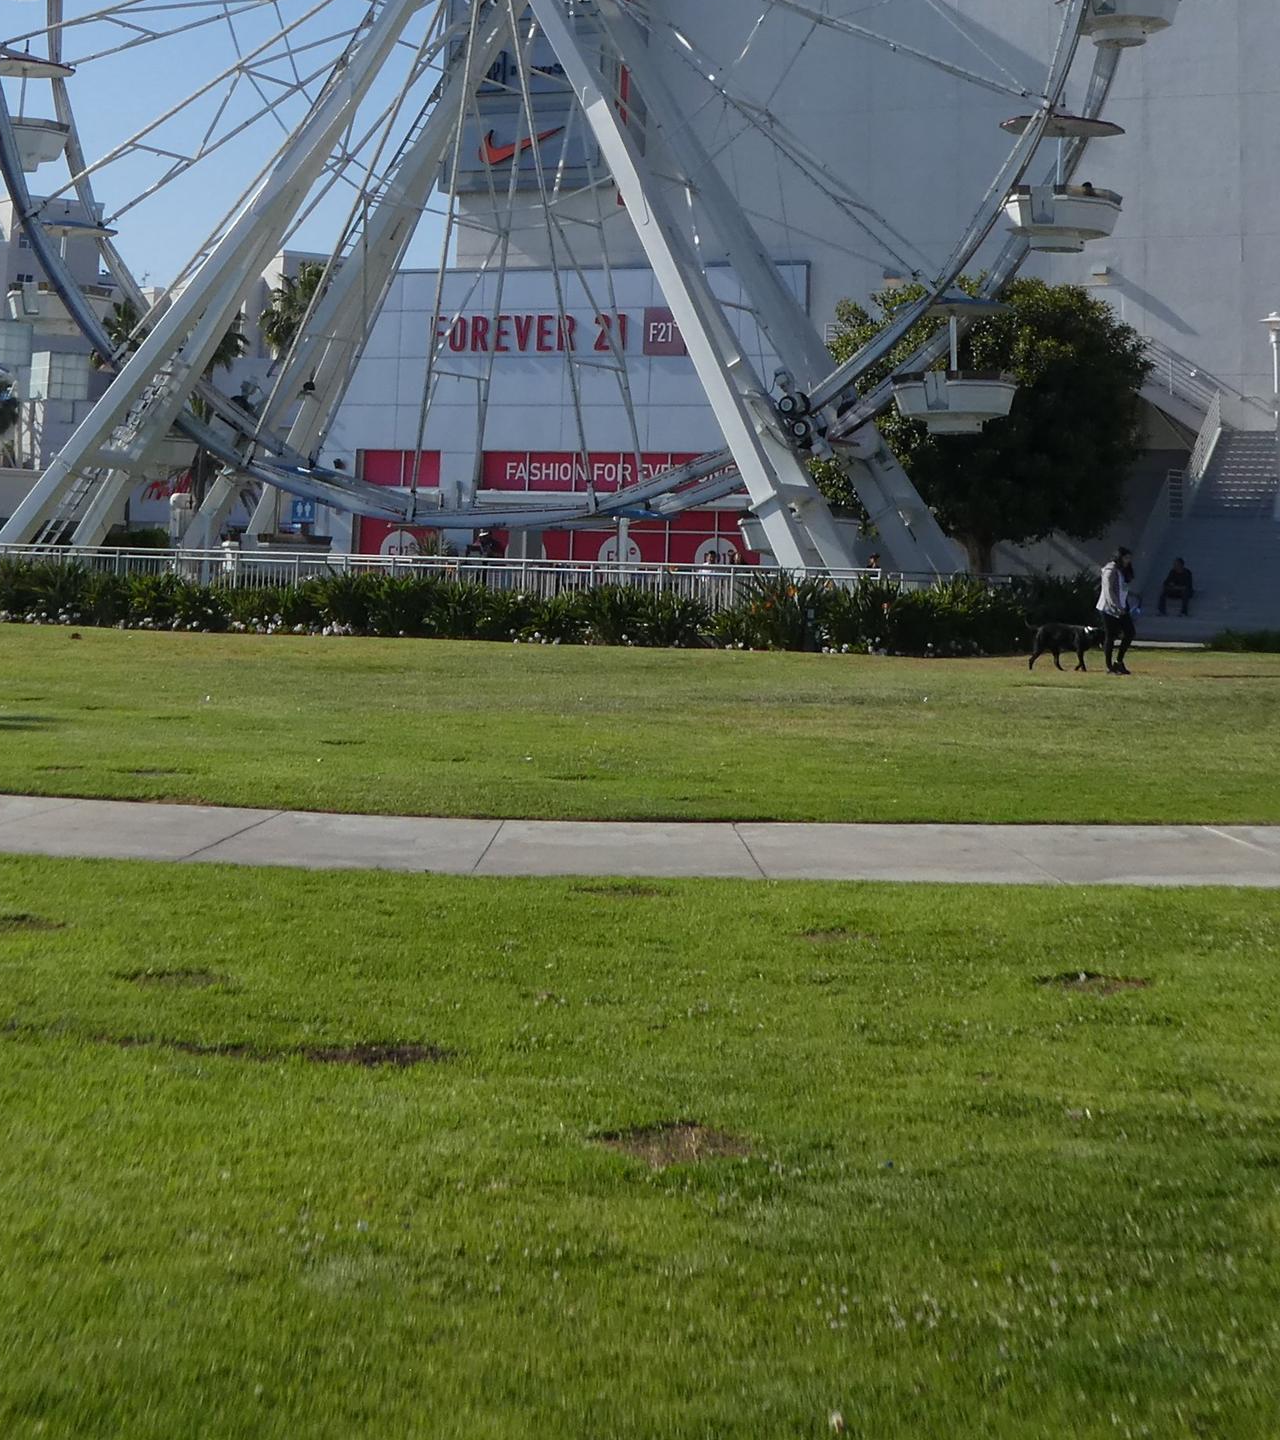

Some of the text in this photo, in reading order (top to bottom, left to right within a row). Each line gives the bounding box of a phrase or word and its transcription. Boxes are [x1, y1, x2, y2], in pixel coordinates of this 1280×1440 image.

[431, 313, 628, 353] FOREVER 21
[505, 462, 590, 482] FASHION
[593, 462, 632, 482] FOR
